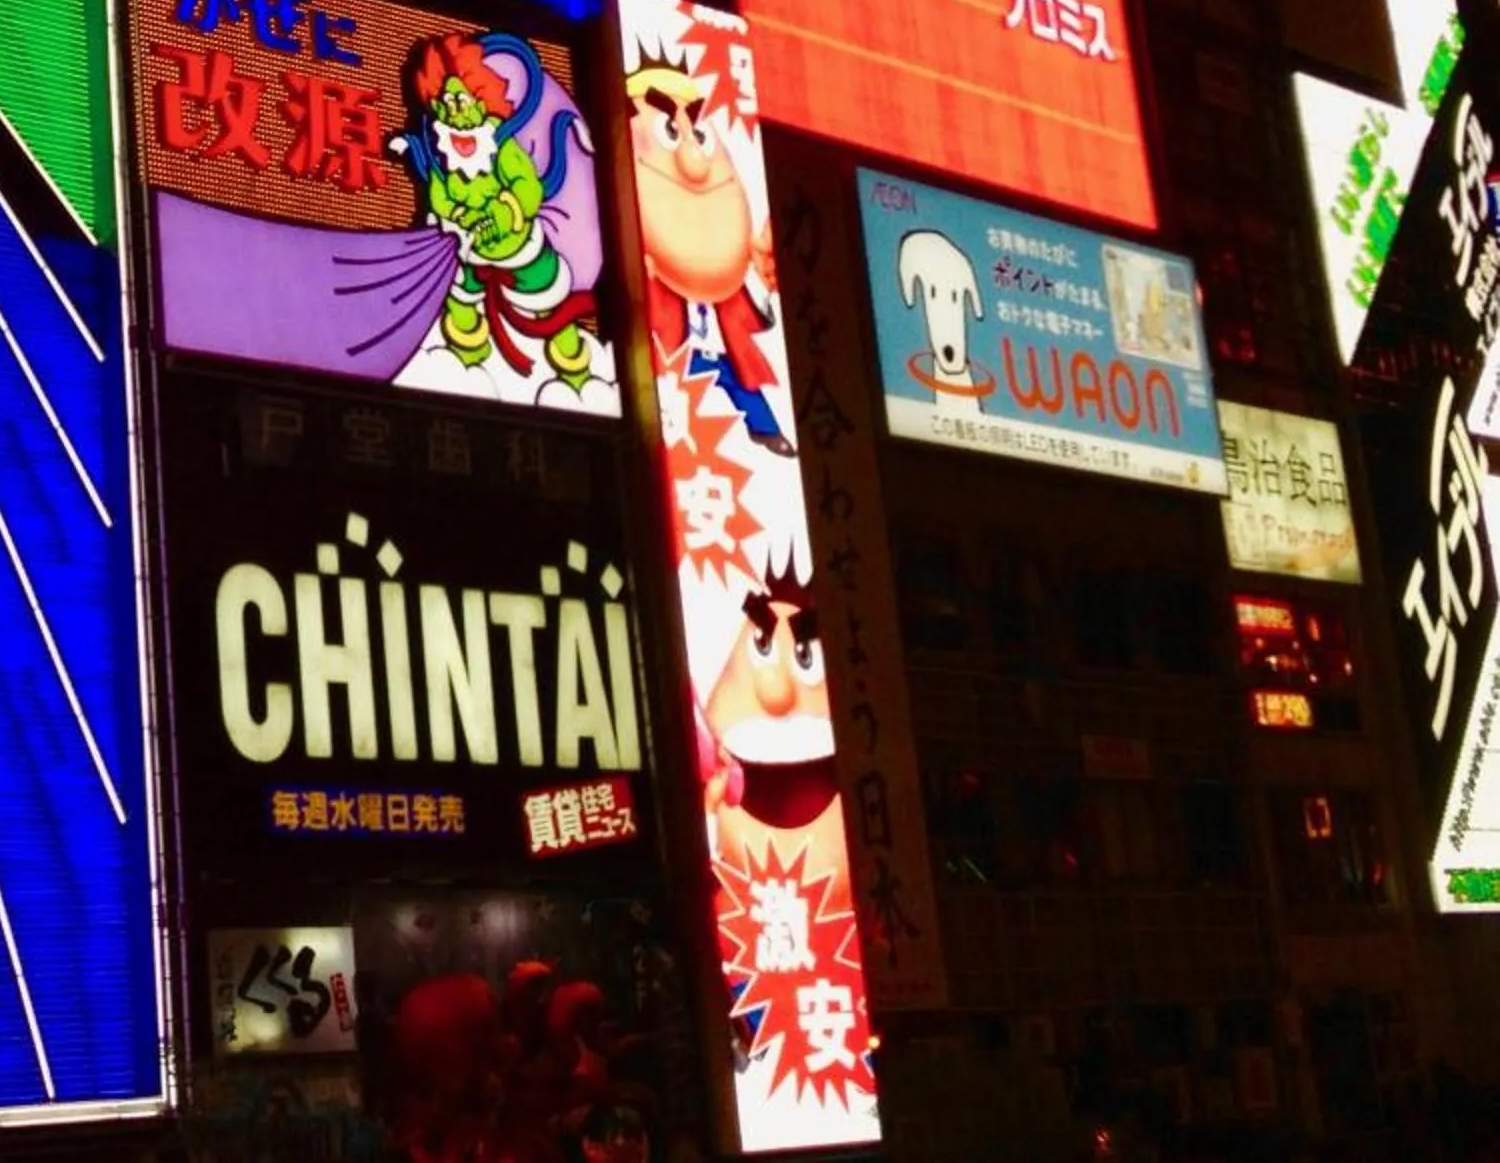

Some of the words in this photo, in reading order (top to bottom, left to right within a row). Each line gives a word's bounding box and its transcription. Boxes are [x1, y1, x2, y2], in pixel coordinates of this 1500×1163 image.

[151, 47, 390, 195] 改源
[1001, 337, 1181, 436] WAON
[216, 514, 642, 771] CHINTAI
[272, 790, 466, 834] 毎週水曜日発売
